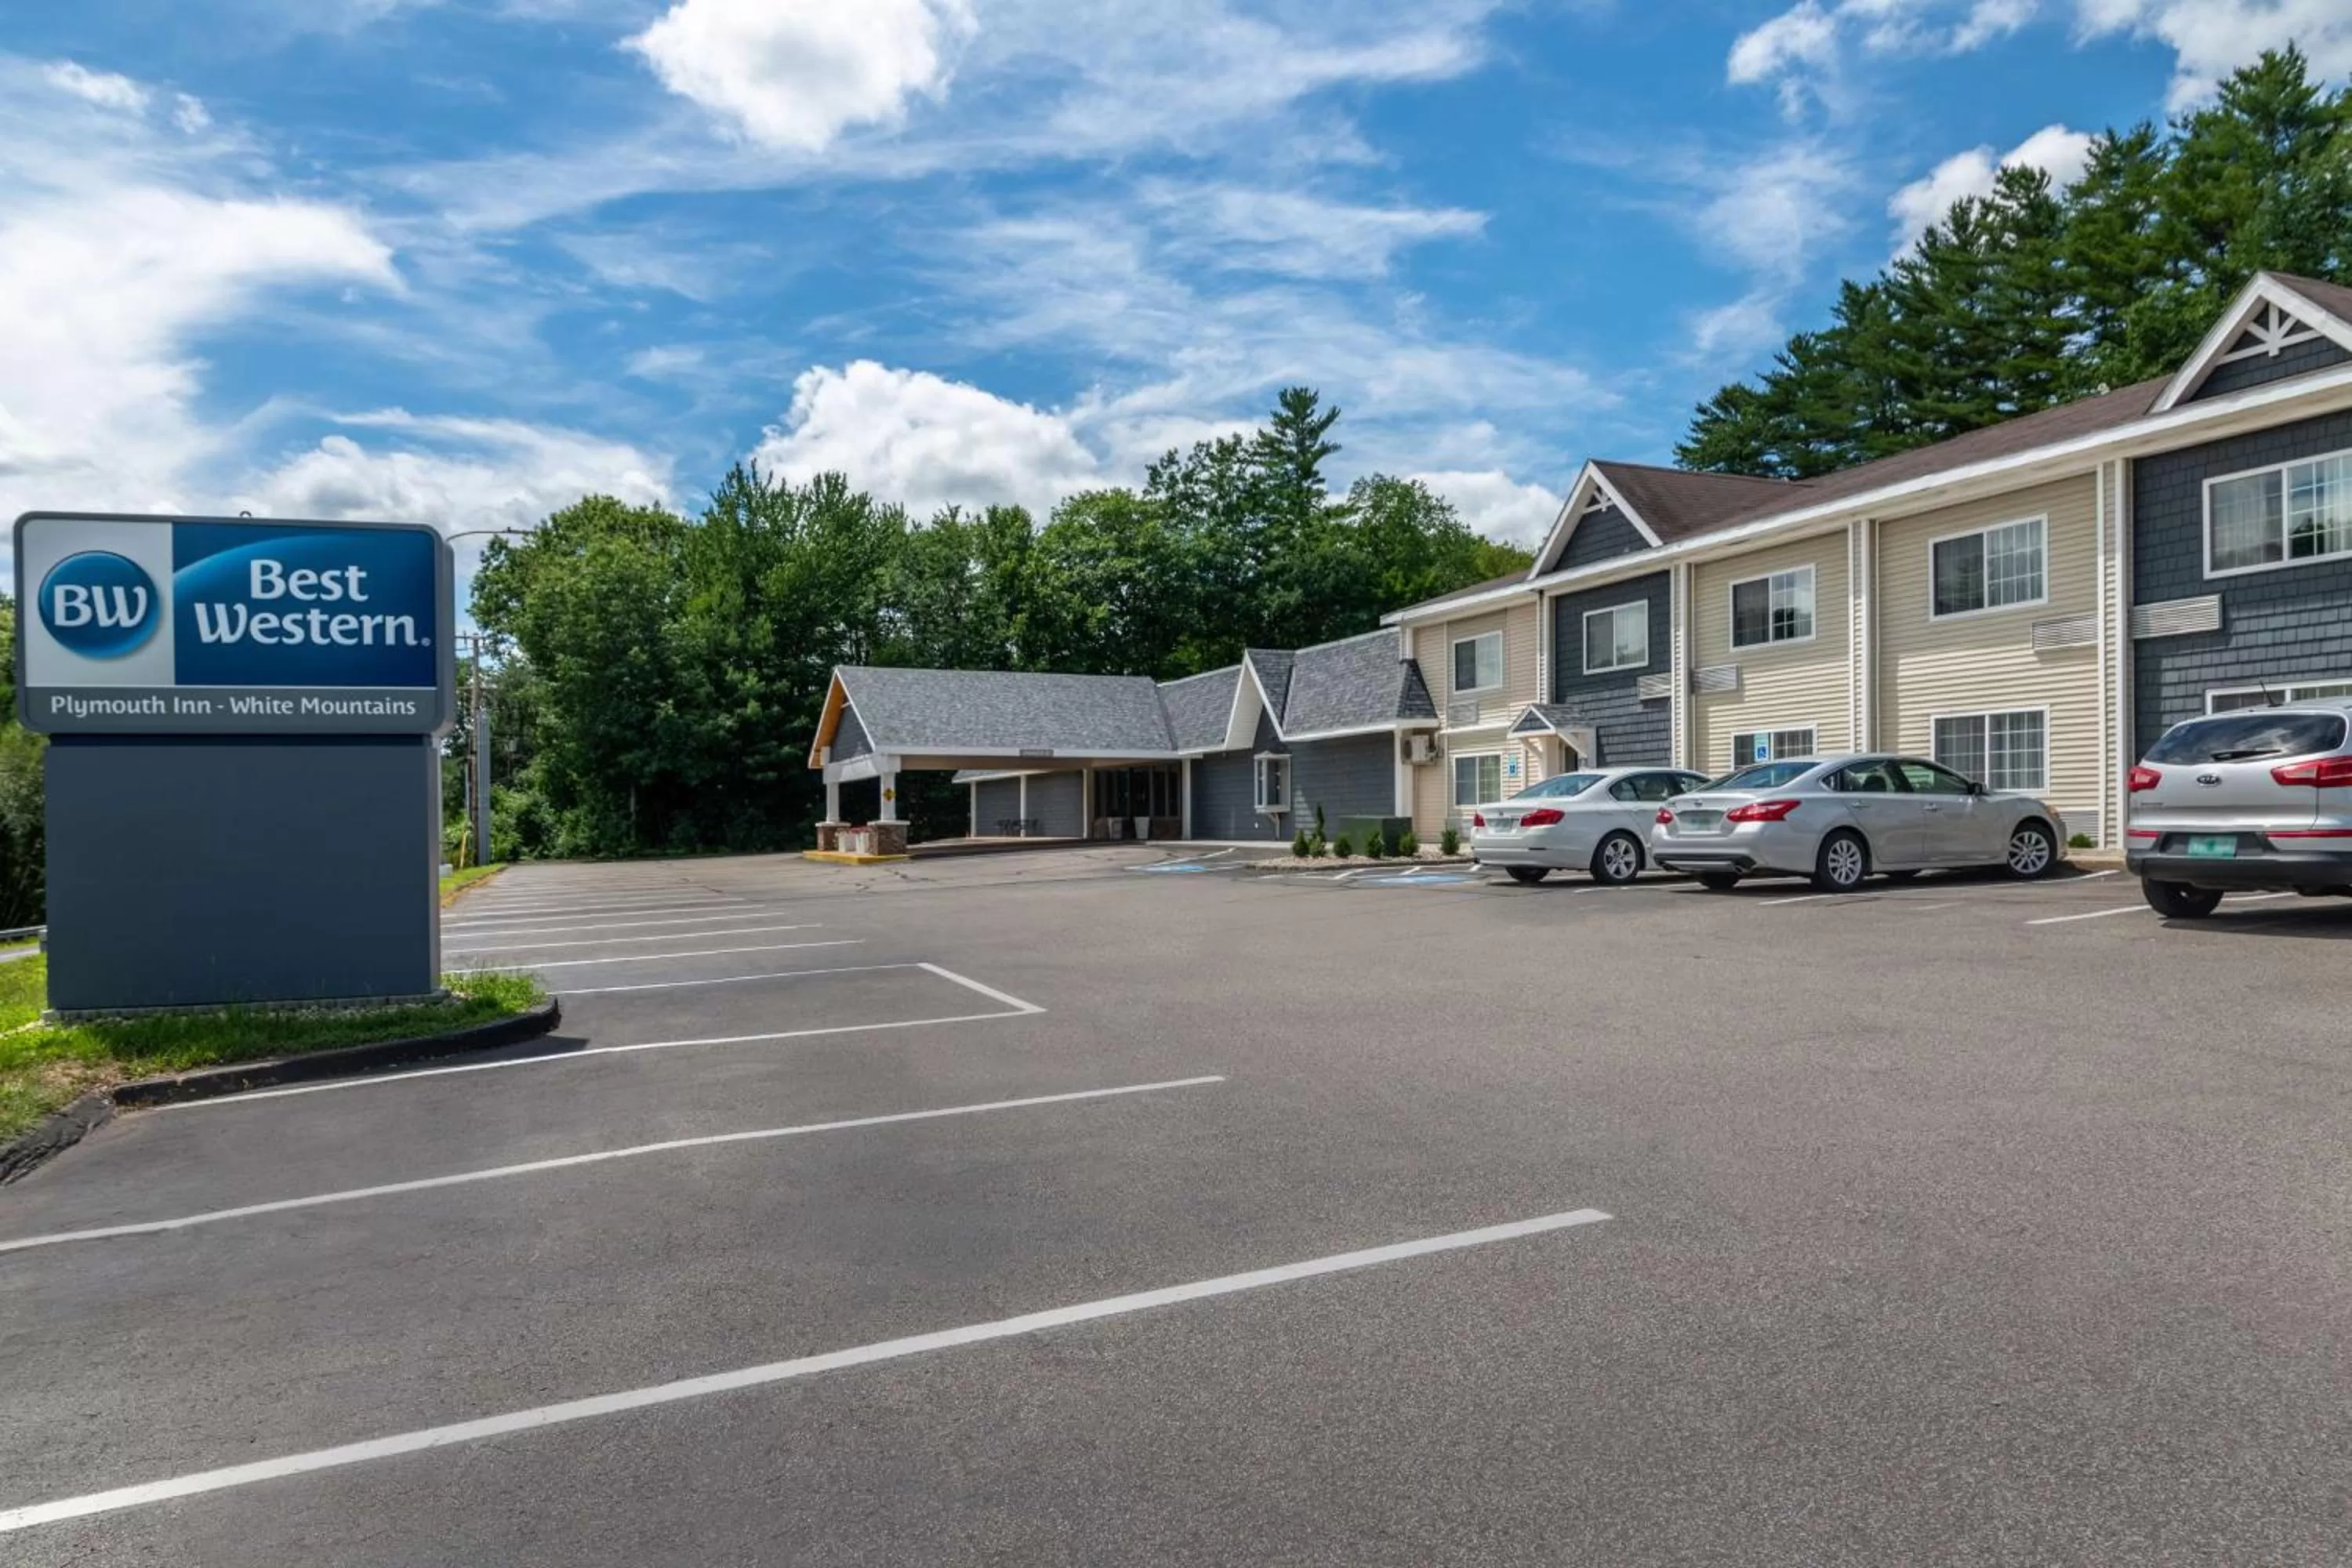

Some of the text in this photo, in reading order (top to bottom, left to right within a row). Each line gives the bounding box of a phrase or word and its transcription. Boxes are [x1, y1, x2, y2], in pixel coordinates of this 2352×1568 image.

[250, 558, 368, 601] Best
[55, 585, 147, 626] BW
[51, 695, 166, 717] Plymouth
[173, 696, 212, 714] Inn
[229, 695, 294, 714] White
[300, 696, 416, 715] Mountains
